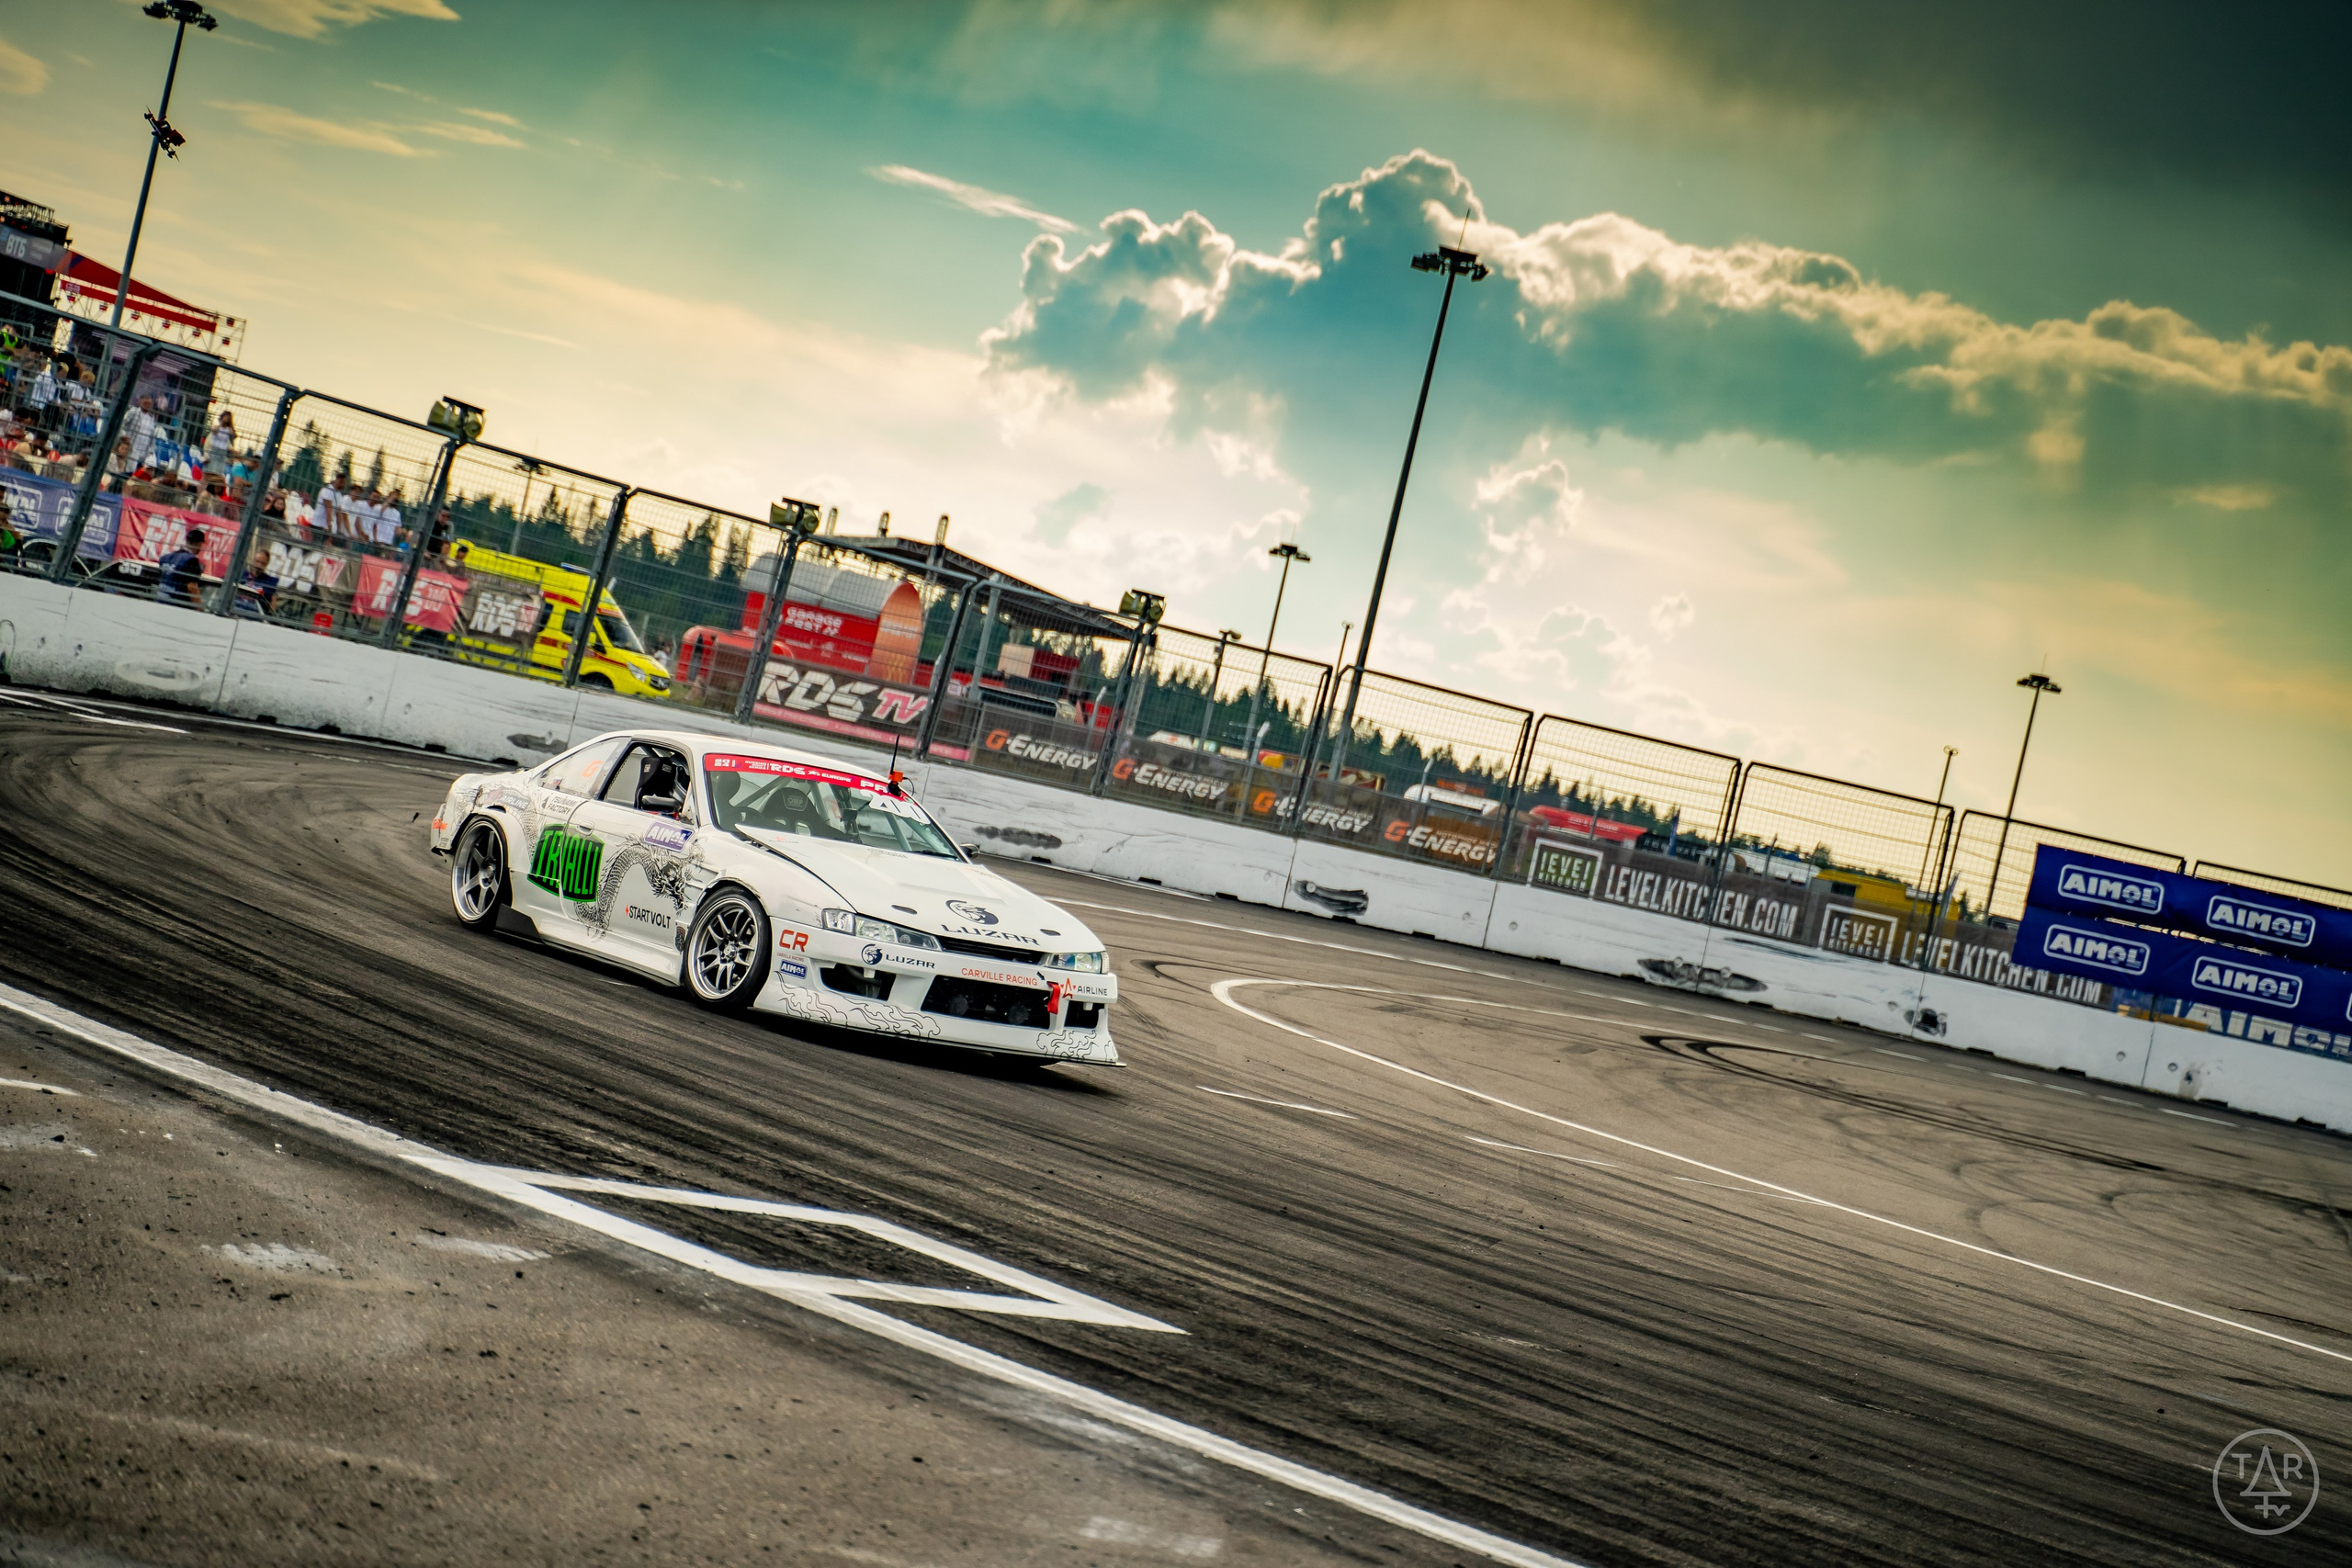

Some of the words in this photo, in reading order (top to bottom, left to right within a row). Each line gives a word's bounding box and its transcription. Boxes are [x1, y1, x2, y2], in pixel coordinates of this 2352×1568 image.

[786, 607, 842, 628] GARAGE
[756, 660, 880, 723] RDS
[872, 687, 931, 725] TV
[769, 763, 806, 775] RDS
[821, 773, 852, 783] EUROPE
[500, 795, 528, 809] AIRLINE
[548, 803, 572, 816] FACTORY
[647, 826, 689, 849] AIMOL
[2063, 873, 2158, 908] AIMOL
[2211, 903, 2308, 942] AIMOL
[779, 929, 809, 953] CR
[941, 924, 1041, 947] LUZAR
[886, 953, 935, 969] LUZAR
[2048, 932, 2142, 969] AIMOL
[781, 963, 806, 976] AIMOL
[961, 967, 1004, 982] CARVILLE
[1005, 976, 1038, 987] RACING
[1077, 986, 1108, 997] AIRLINE
[2197, 964, 2294, 1002] AIMOL
